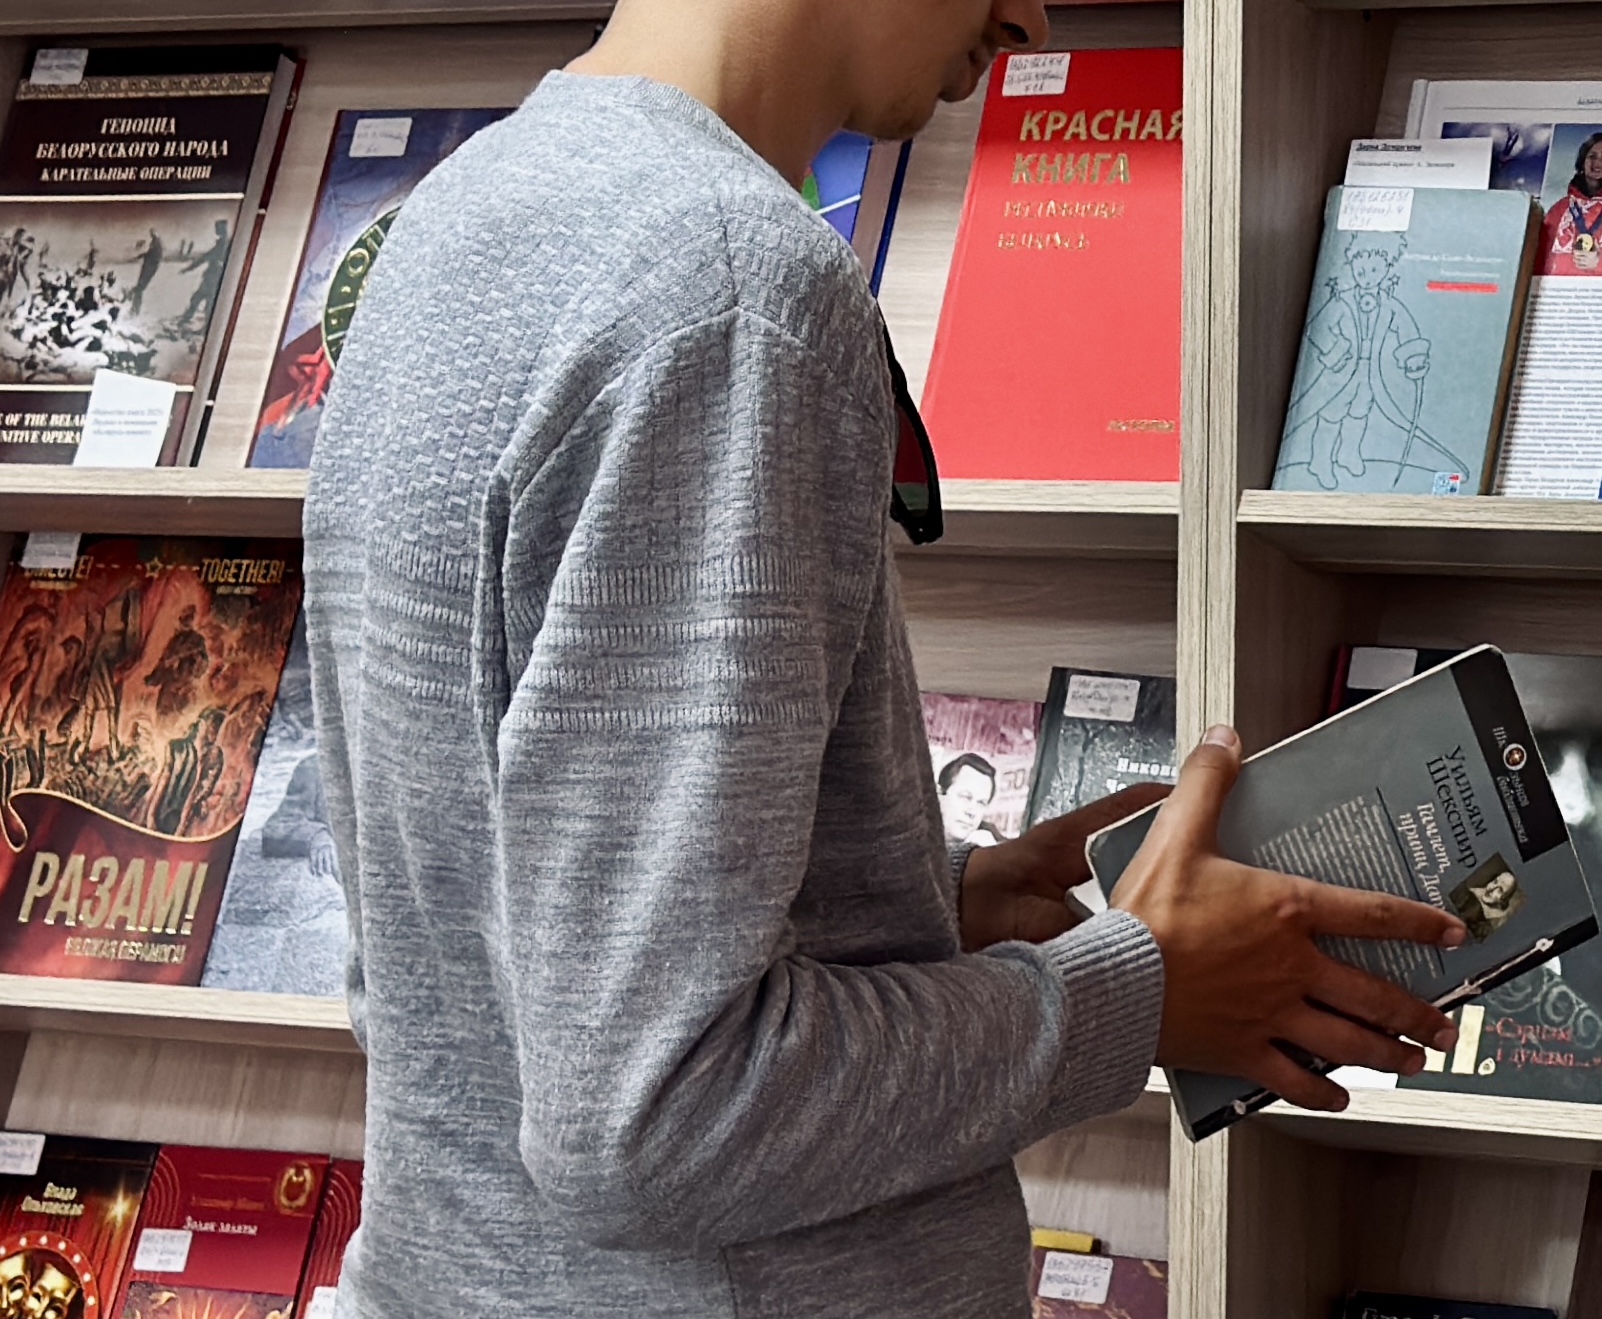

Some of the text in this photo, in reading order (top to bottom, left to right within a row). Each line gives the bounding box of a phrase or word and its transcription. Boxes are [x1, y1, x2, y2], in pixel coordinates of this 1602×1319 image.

[100, 117, 177, 136] ГЕНОЦИД
[1019, 109, 1184, 141] КРАСНАЯ
[35, 139, 229, 159] БЕЛОРУССКОГО НАРОДА
[39, 165, 213, 181] КАРАТЕЛЬНЫЕ ОПЕРАЦИИ
[1012, 152, 1132, 184] КНИГА
[5, 413, 23, 428] OF
[24, 413, 48, 427] THE
[199, 557, 286, 586] TOGETHER!
[1445, 743, 1489, 837] Уильям
[1426, 755, 1478, 869] Шекспир
[1397, 812, 1431, 872] принц
[1416, 801, 1452, 874] Гамлет,
[16, 851, 209, 936] РАЗАМ!
